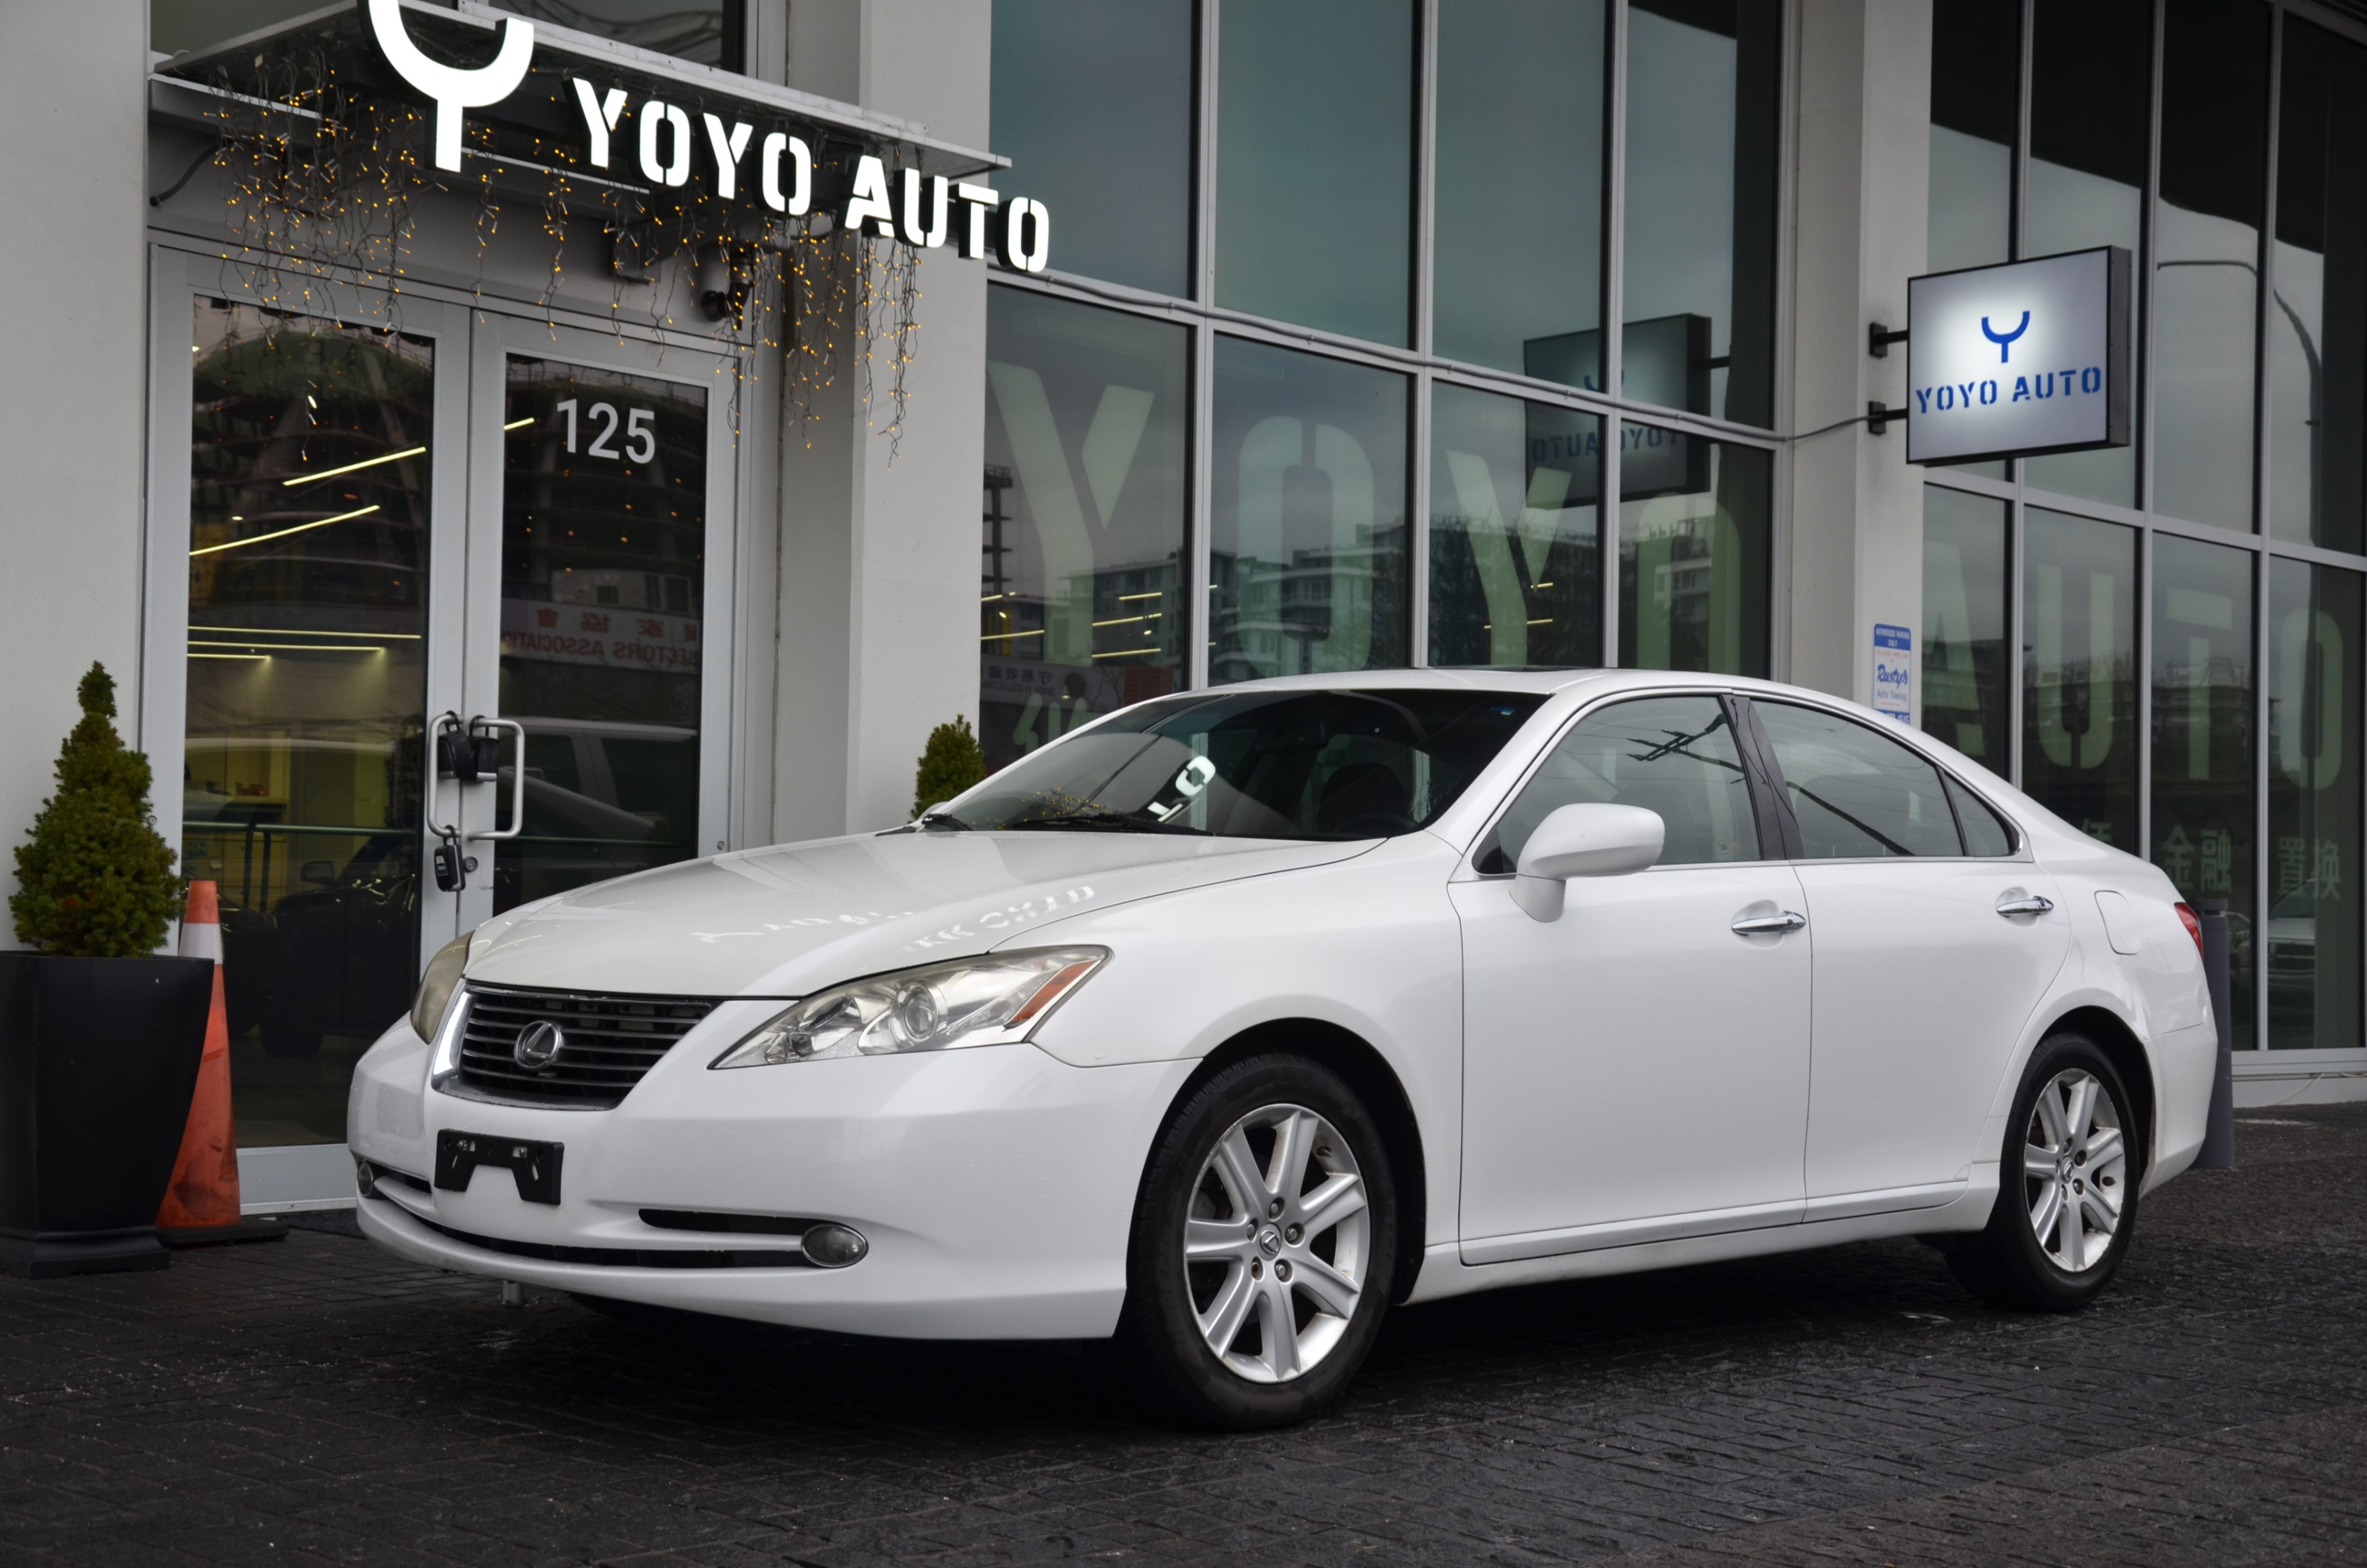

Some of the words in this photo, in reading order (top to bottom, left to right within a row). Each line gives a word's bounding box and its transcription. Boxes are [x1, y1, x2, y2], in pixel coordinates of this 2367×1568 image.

[570, 77, 812, 217] YOYO
[844, 155, 1050, 273] AUTO
[1916, 379, 1998, 414] YOYO
[2012, 366, 2101, 402] AUTO
[556, 398, 656, 464] 125
[1877, 664, 1908, 689] Rusty's
[1877, 689, 1889, 699] Auto
[1890, 690, 1907, 702] Towing
[2160, 824, 2232, 892] 金融
[2277, 834, 2342, 901] 置换
